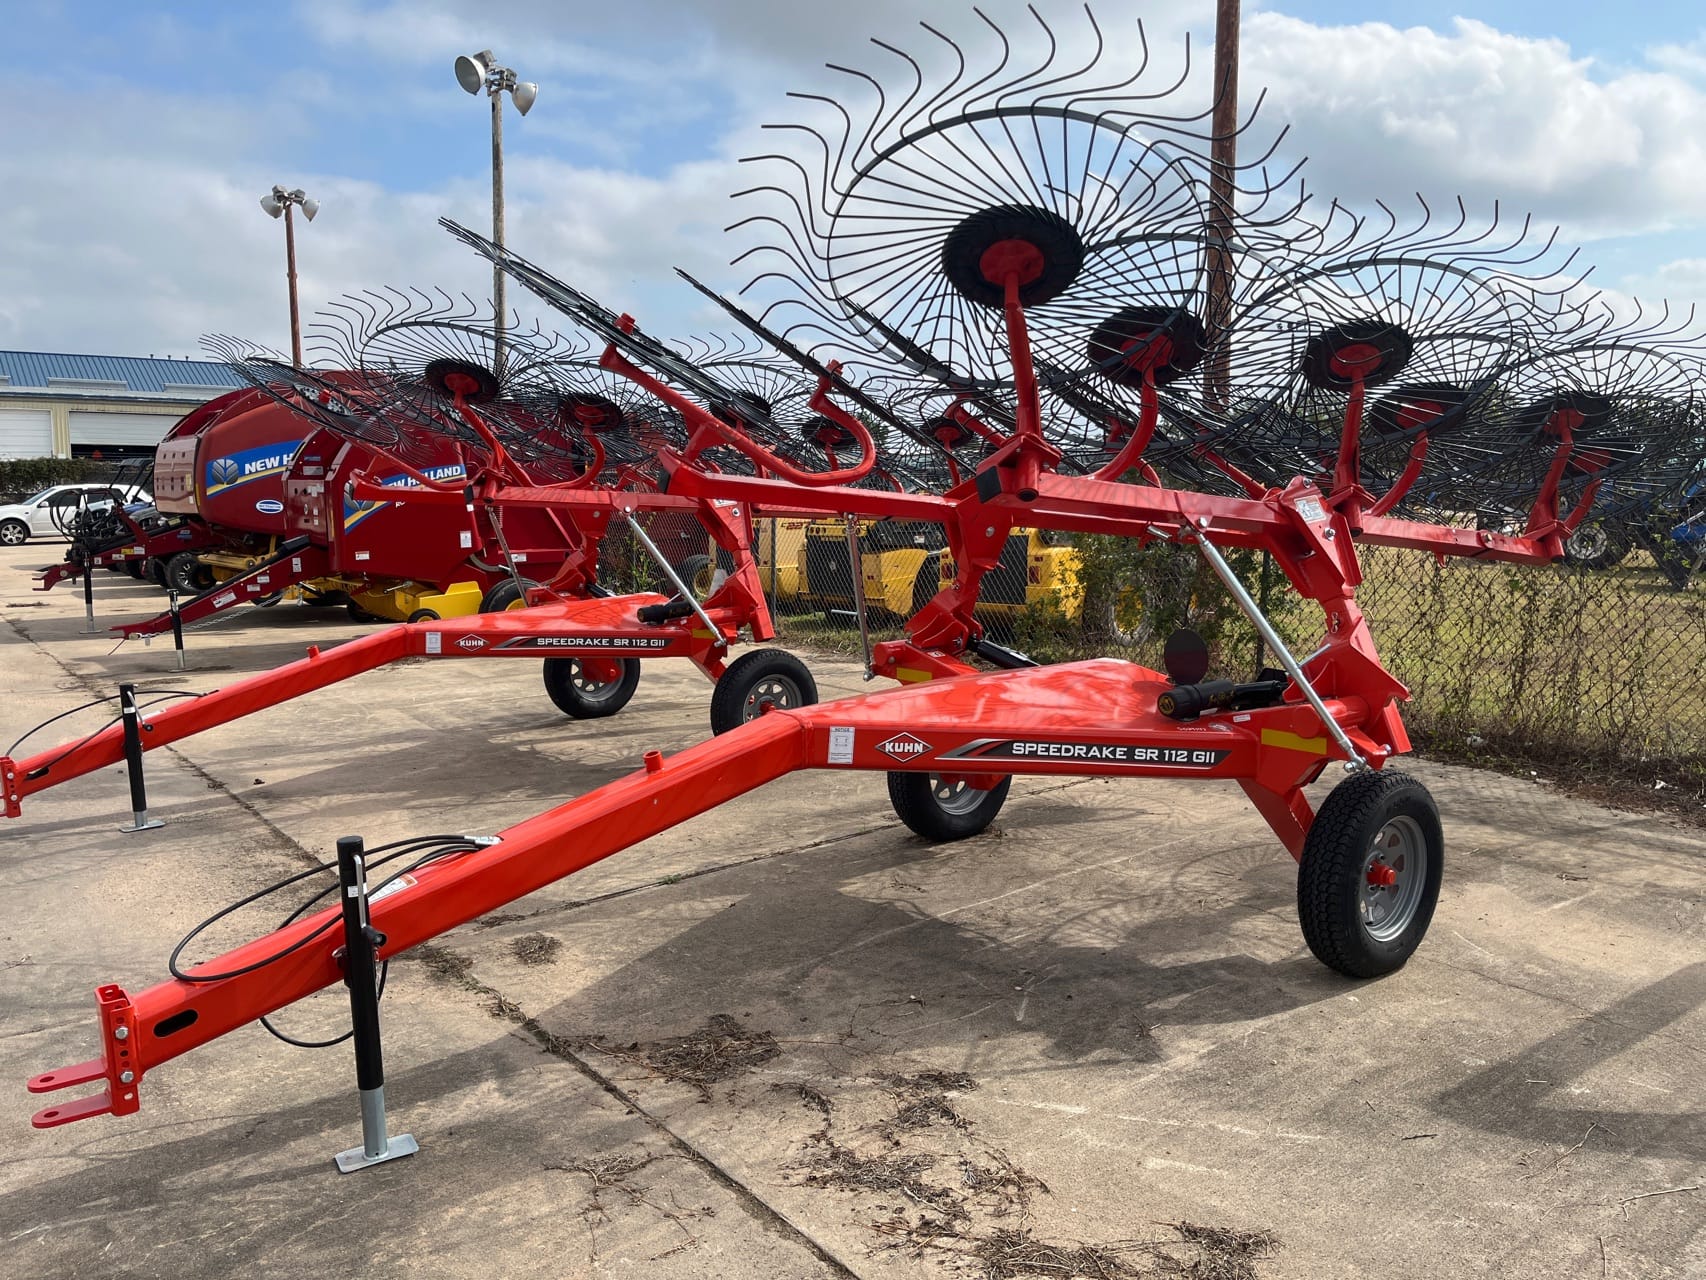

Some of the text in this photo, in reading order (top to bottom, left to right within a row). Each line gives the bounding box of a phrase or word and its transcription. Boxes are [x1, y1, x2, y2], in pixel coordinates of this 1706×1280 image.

[244, 456, 280, 475] NEW
[459, 639, 484, 647] KUHN
[537, 637, 665, 647] SPEEDRAKE SR 112 GII
[885, 742, 924, 753] KUHN
[1012, 742, 1216, 764] SPEEDRAKE SR 112 GII
